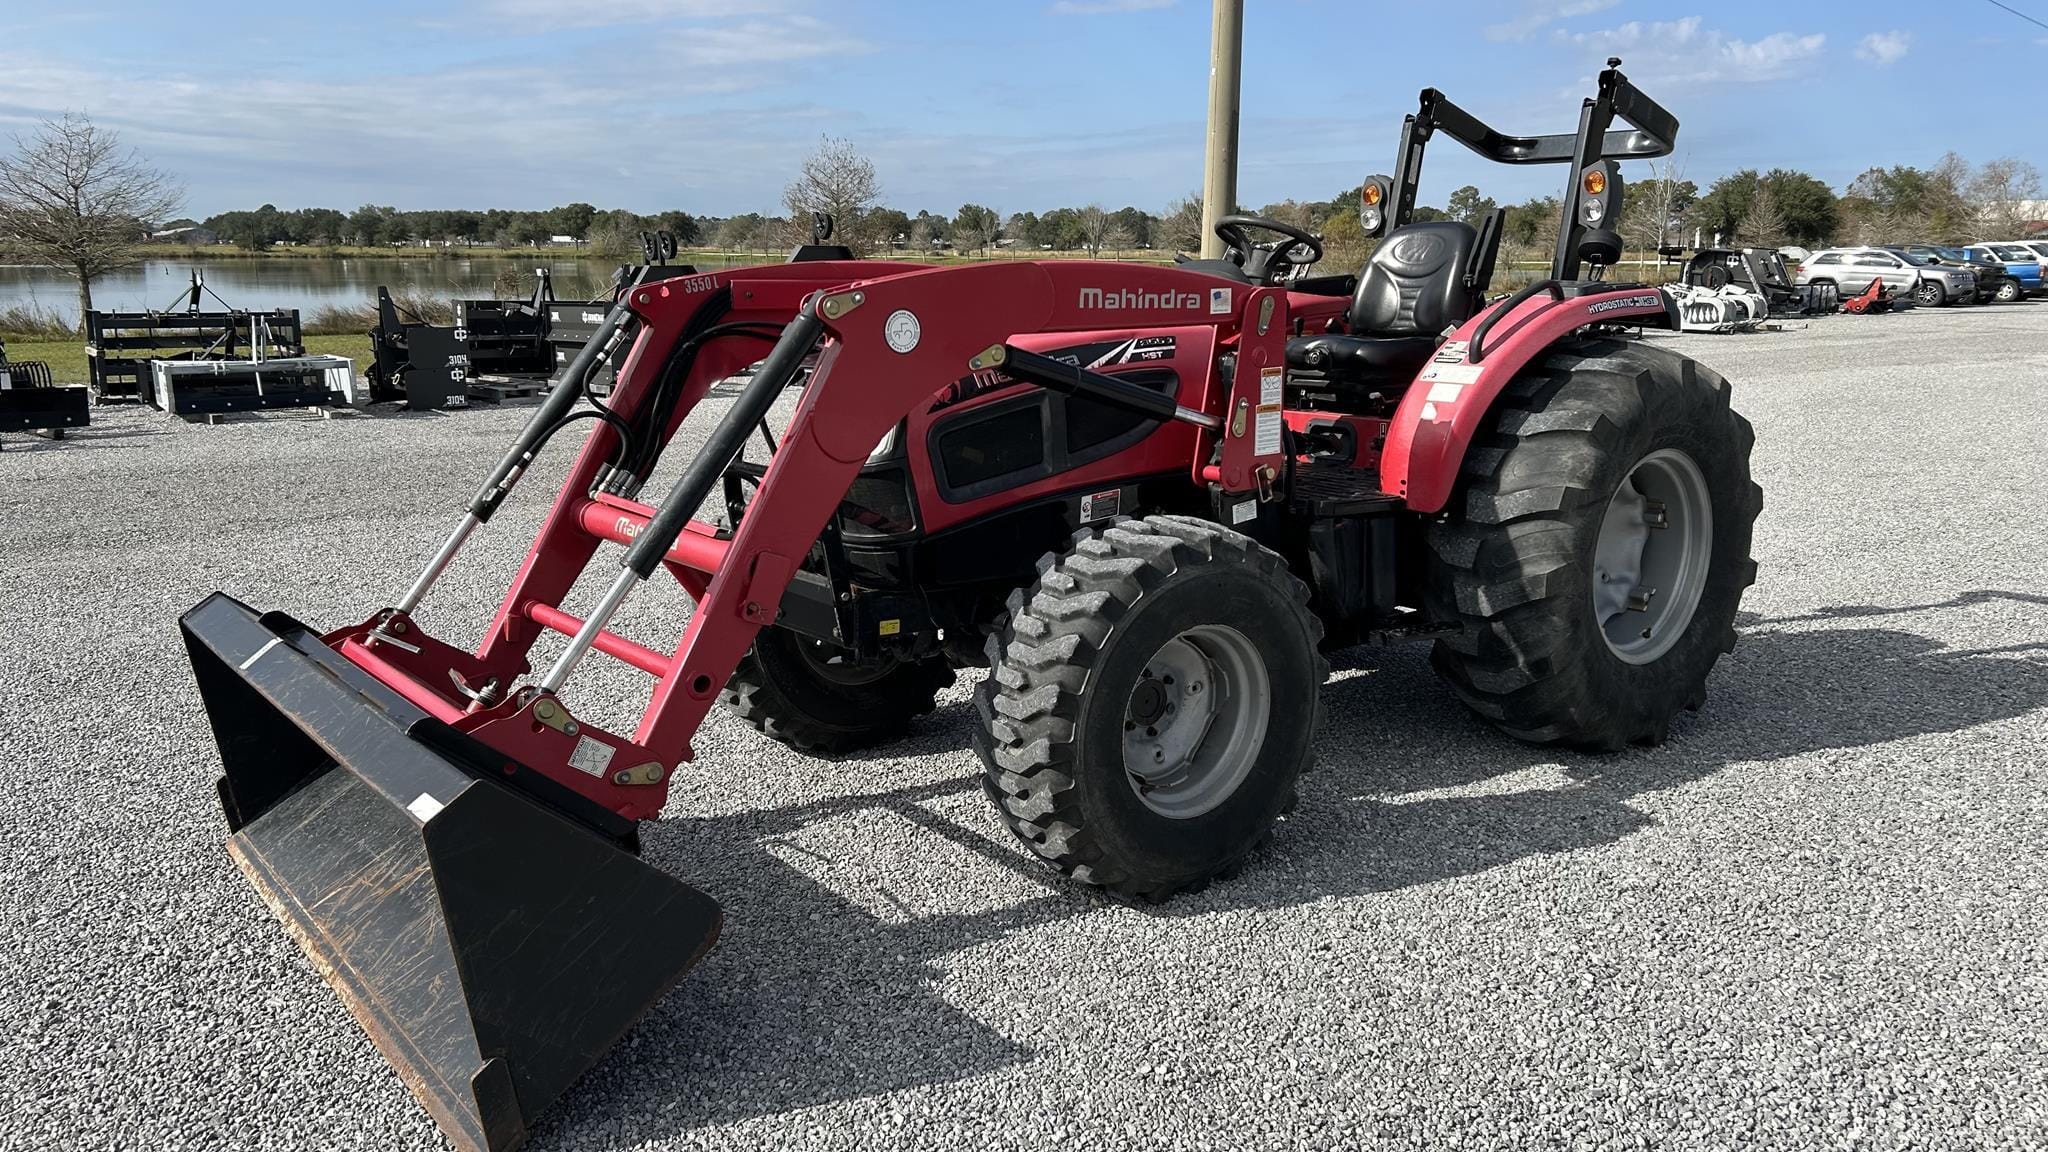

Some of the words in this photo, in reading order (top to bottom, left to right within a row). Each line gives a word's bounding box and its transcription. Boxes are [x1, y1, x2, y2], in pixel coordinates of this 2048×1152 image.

[684, 276, 712, 294] 3550
[1079, 288, 1200, 309] Mahindra
[1587, 297, 1634, 314] HYDROSTATIC
[448, 354, 467, 365] 3104
[1141, 351, 1163, 360] HST
[446, 395, 465, 405] 3104
